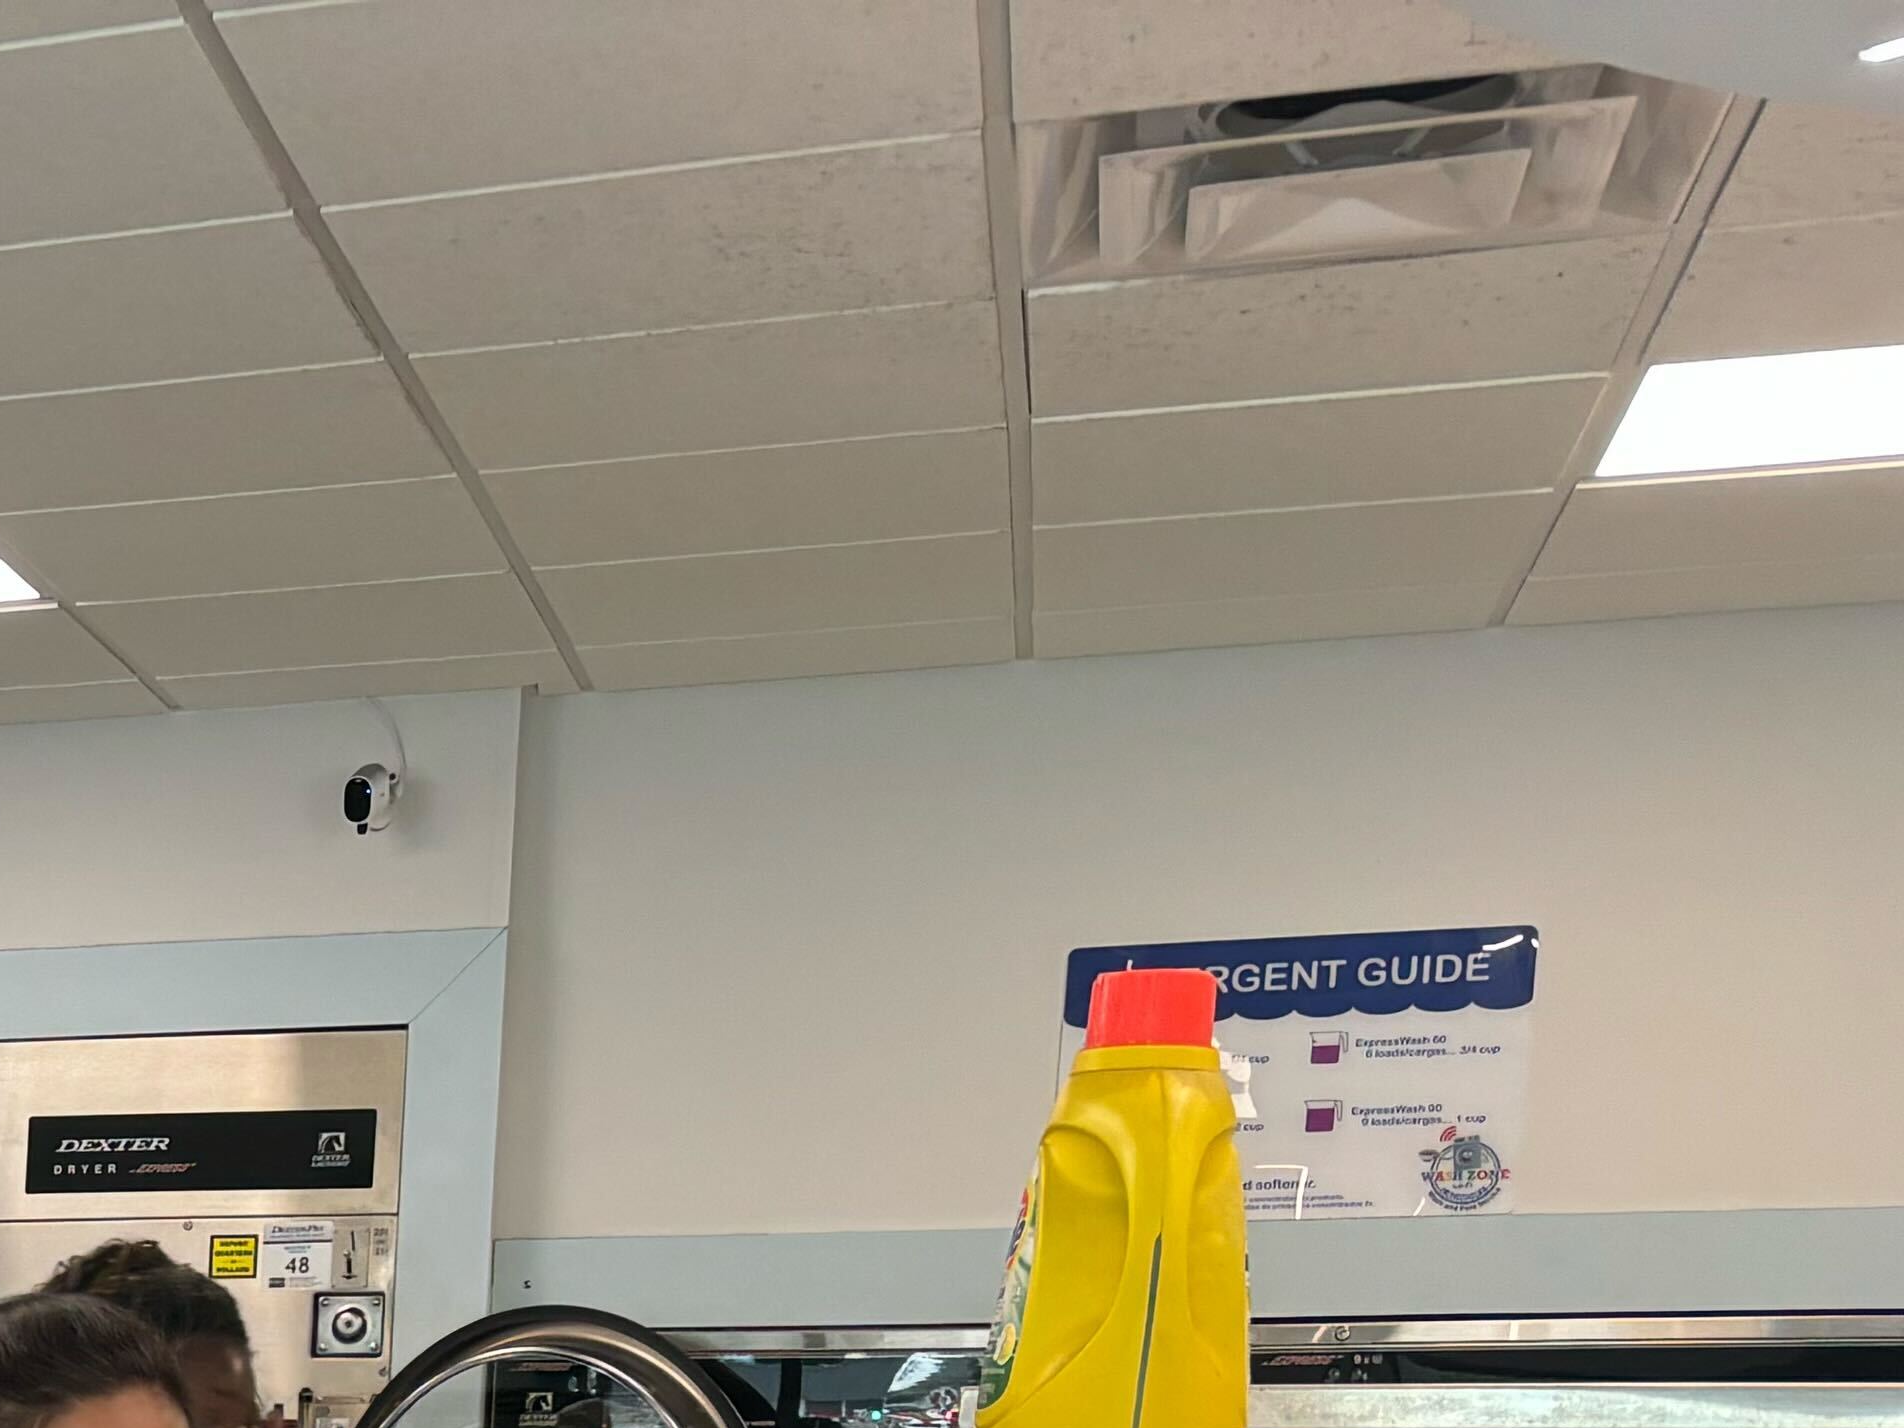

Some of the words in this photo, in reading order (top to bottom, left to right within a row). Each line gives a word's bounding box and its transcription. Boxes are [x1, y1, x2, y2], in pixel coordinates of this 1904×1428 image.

[1214, 960, 1346, 993] RGENT
[1357, 952, 1490, 986] GUIDE
[1479, 1045, 1501, 1056] cup
[1465, 1115, 1486, 1124] cup
[55, 1137, 170, 1153] DEXTER
[53, 1163, 117, 1175] DRYER
[285, 1256, 311, 1275] 48
